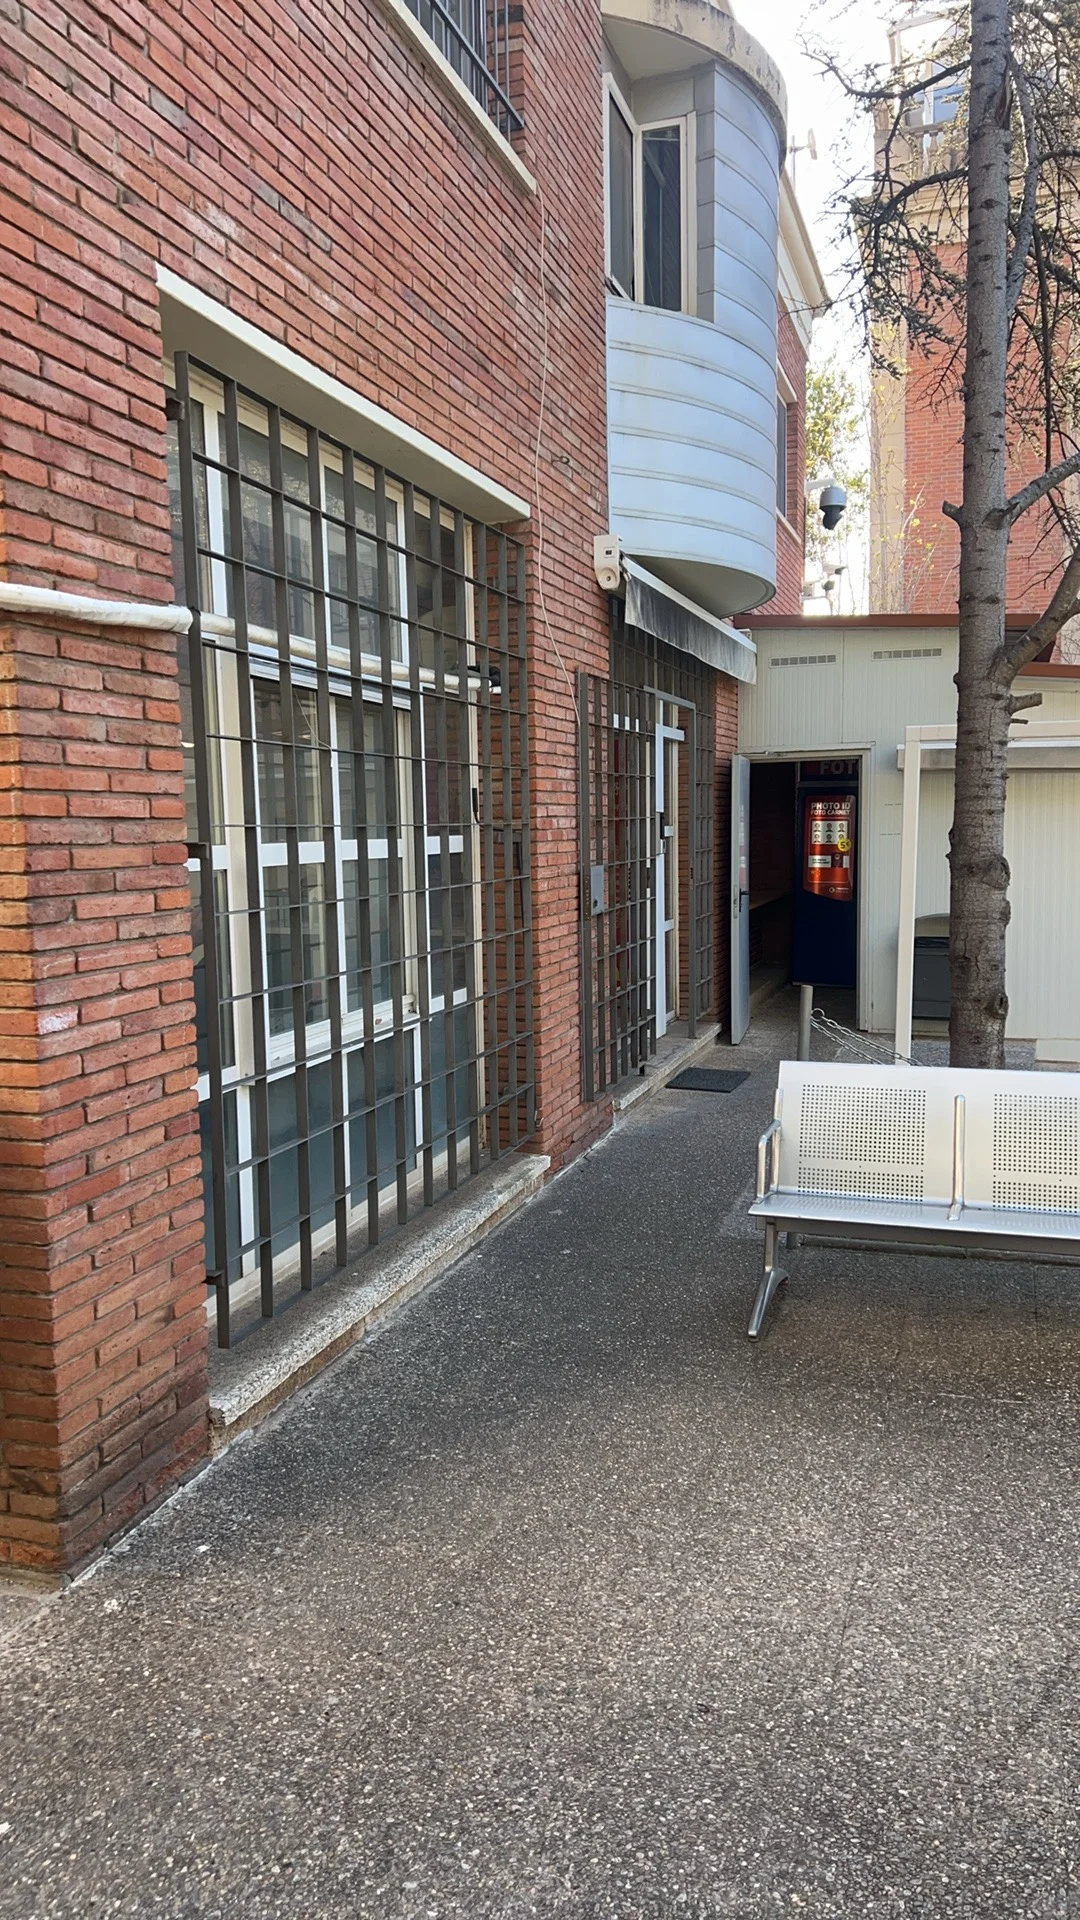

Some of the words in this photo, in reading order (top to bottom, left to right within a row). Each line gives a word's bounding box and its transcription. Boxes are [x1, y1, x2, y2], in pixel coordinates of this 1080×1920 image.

[820, 760, 859, 774] FOT
[811, 802, 840, 810] PHOTO
[841, 802, 851, 810] ID
